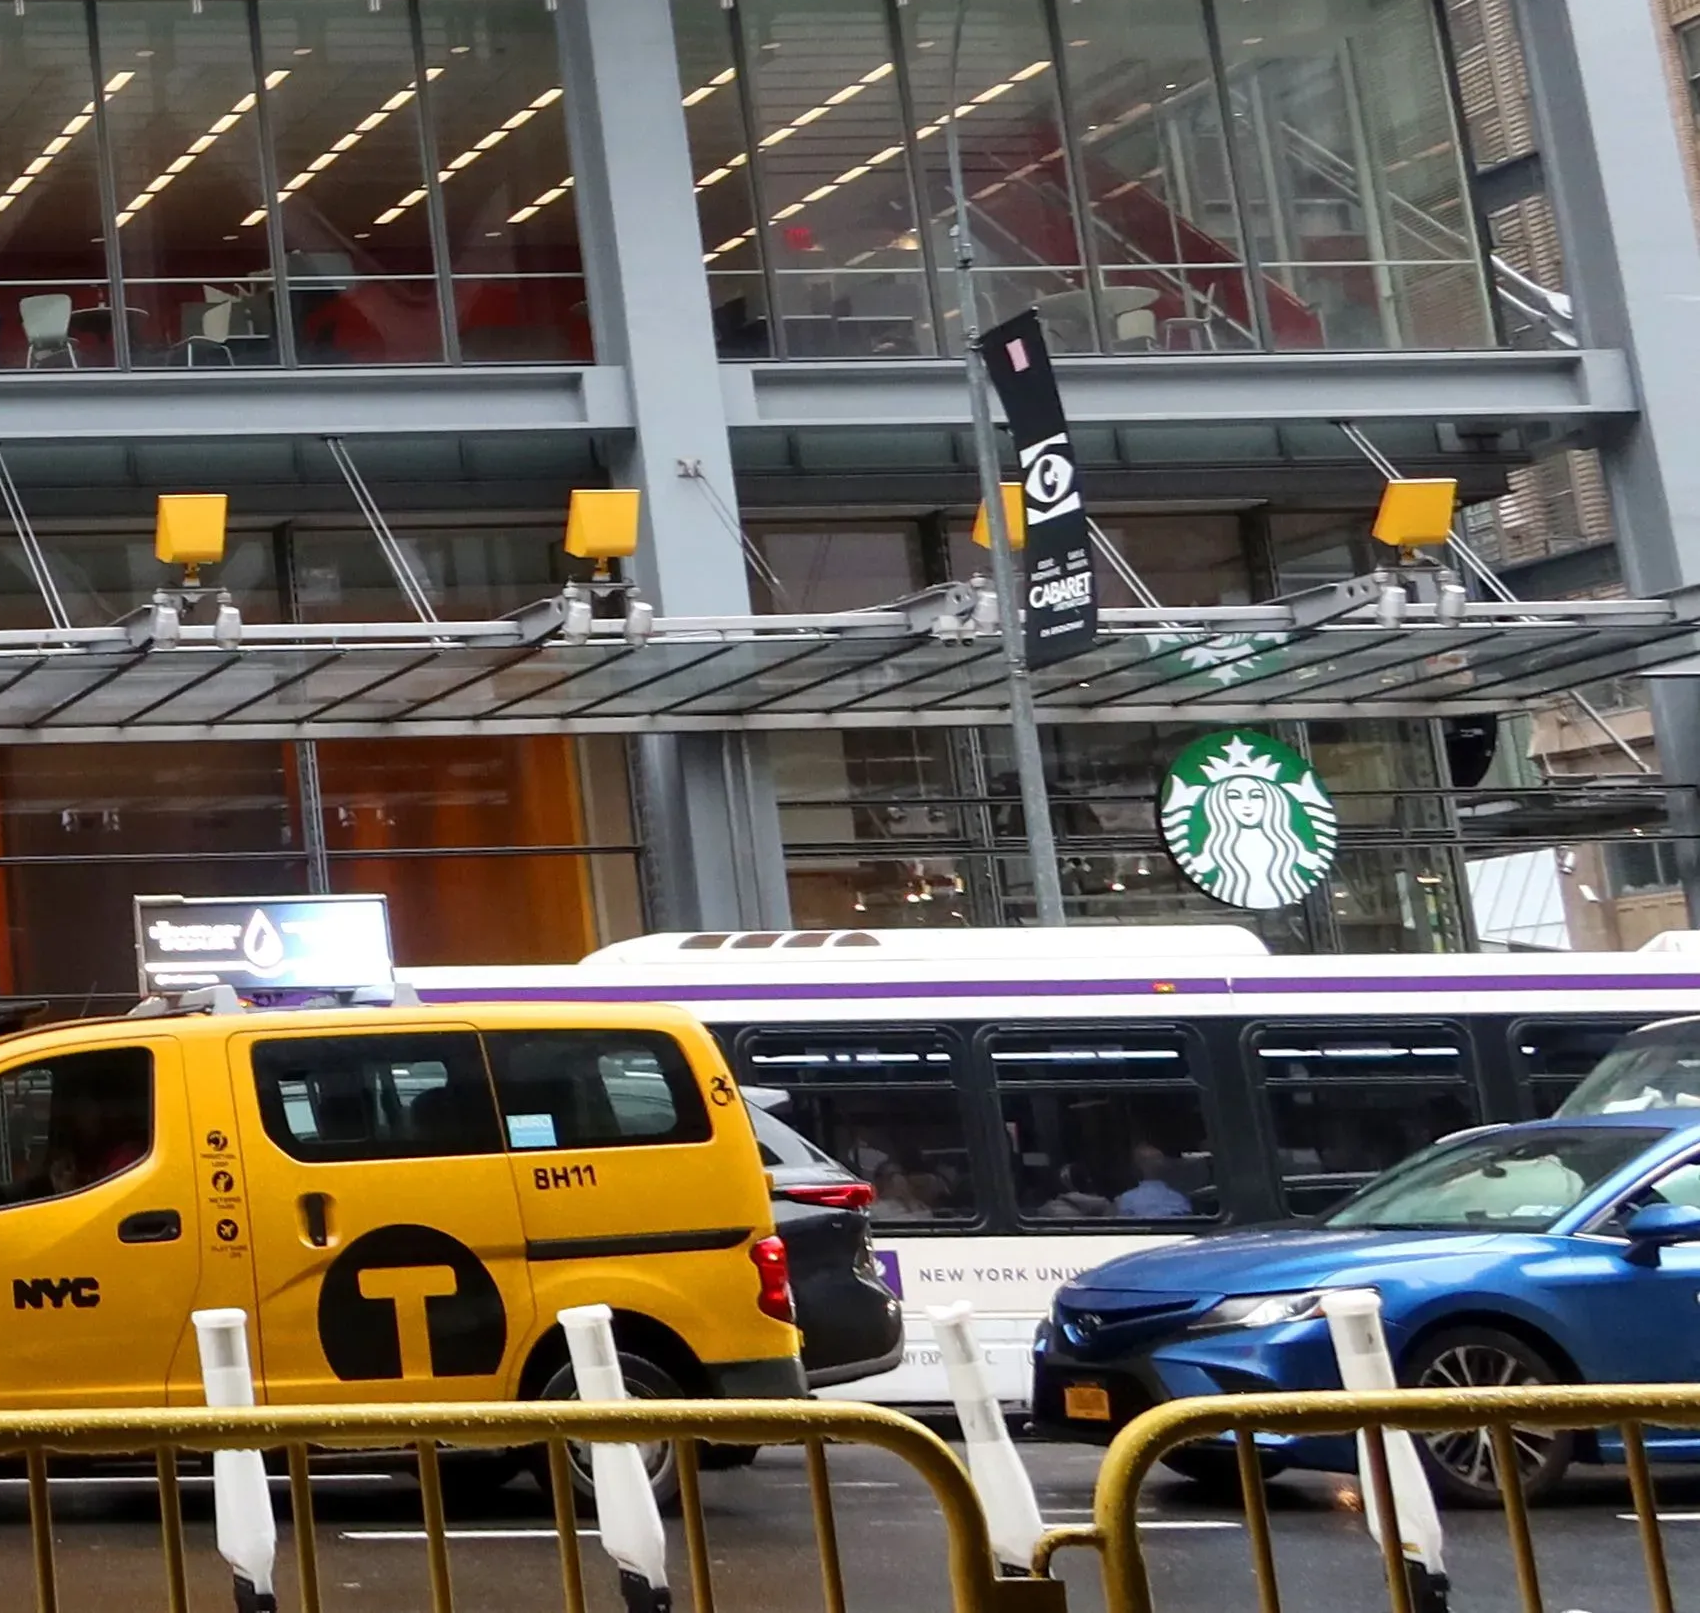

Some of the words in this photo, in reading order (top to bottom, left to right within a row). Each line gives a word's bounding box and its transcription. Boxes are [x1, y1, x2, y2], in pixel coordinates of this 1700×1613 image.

[1029, 571, 1092, 609] CABARET
[533, 1164, 597, 1190] 8H11
[919, 1268, 965, 1282] NEW
[973, 1268, 1028, 1282] YORK
[1036, 1267, 1088, 1283] UNIV
[13, 1277, 100, 1309] NYC
[920, 1351, 943, 1366] EXP
